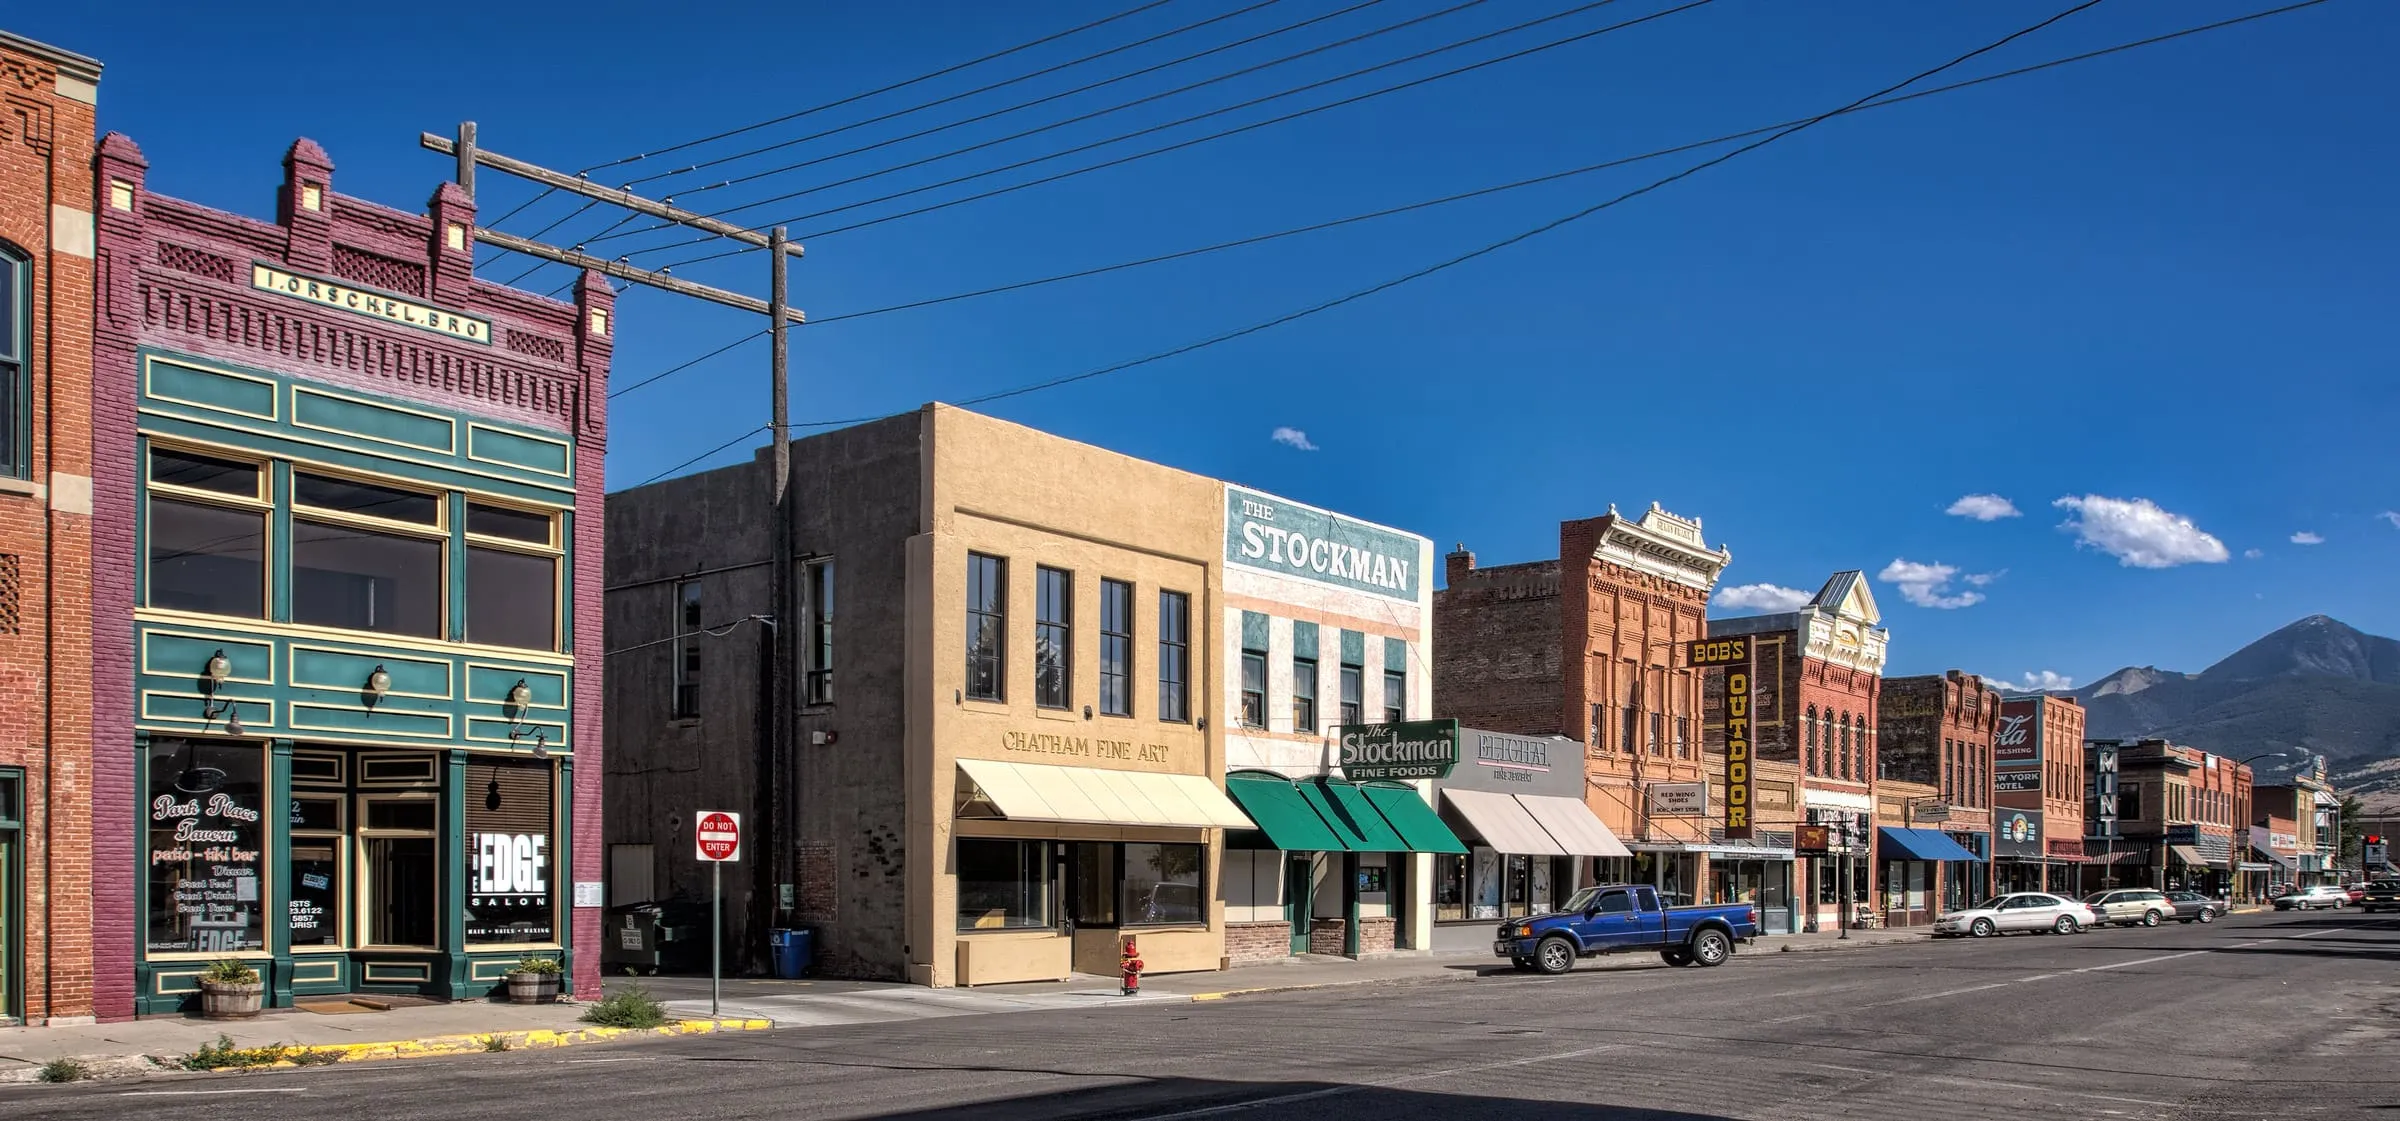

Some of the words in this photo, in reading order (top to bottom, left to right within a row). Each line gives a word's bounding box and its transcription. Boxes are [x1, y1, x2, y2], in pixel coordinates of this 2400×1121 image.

[1242, 499, 1274, 521] THE
[1241, 520, 1409, 592] STOCKMAN
[1693, 640, 1745, 663] BOB'S
[1364, 724, 1392, 738] The
[1002, 730, 1089, 757] CHATHAM
[1096, 739, 1131, 760] FINE
[1137, 743, 1169, 763] ART
[1341, 731, 1453, 765] Stockman
[1728, 673, 1748, 828] OUTDOOR
[1996, 747, 2033, 755] RESHING
[1352, 767, 1385, 778] FINE
[1389, 766, 1438, 777] FOODS
[2010, 772, 2040, 781] YORK
[1994, 782, 2025, 790] HOTEL
[2099, 752, 2118, 836] MINT
[153, 794, 200, 820] Park
[205, 793, 259, 822] Place
[290, 814, 306, 824] ain
[174, 817, 238, 842] Tavern
[703, 822, 715, 831] DO
[717, 822, 733, 831] NOT
[706, 842, 731, 852] ENTER
[152, 846, 192, 866] patio
[204, 846, 231, 861] tiki
[232, 846, 259, 861] bar
[480, 833, 545, 893] EDGE
[179, 878, 207, 889] Great
[209, 878, 233, 889] Food
[174, 890, 202, 901] Great
[204, 890, 237, 901] Drinks
[177, 903, 206, 913] Great
[289, 900, 311, 908] ISTS
[471, 897, 546, 907] SALON
[290, 921, 319, 929] URIST
